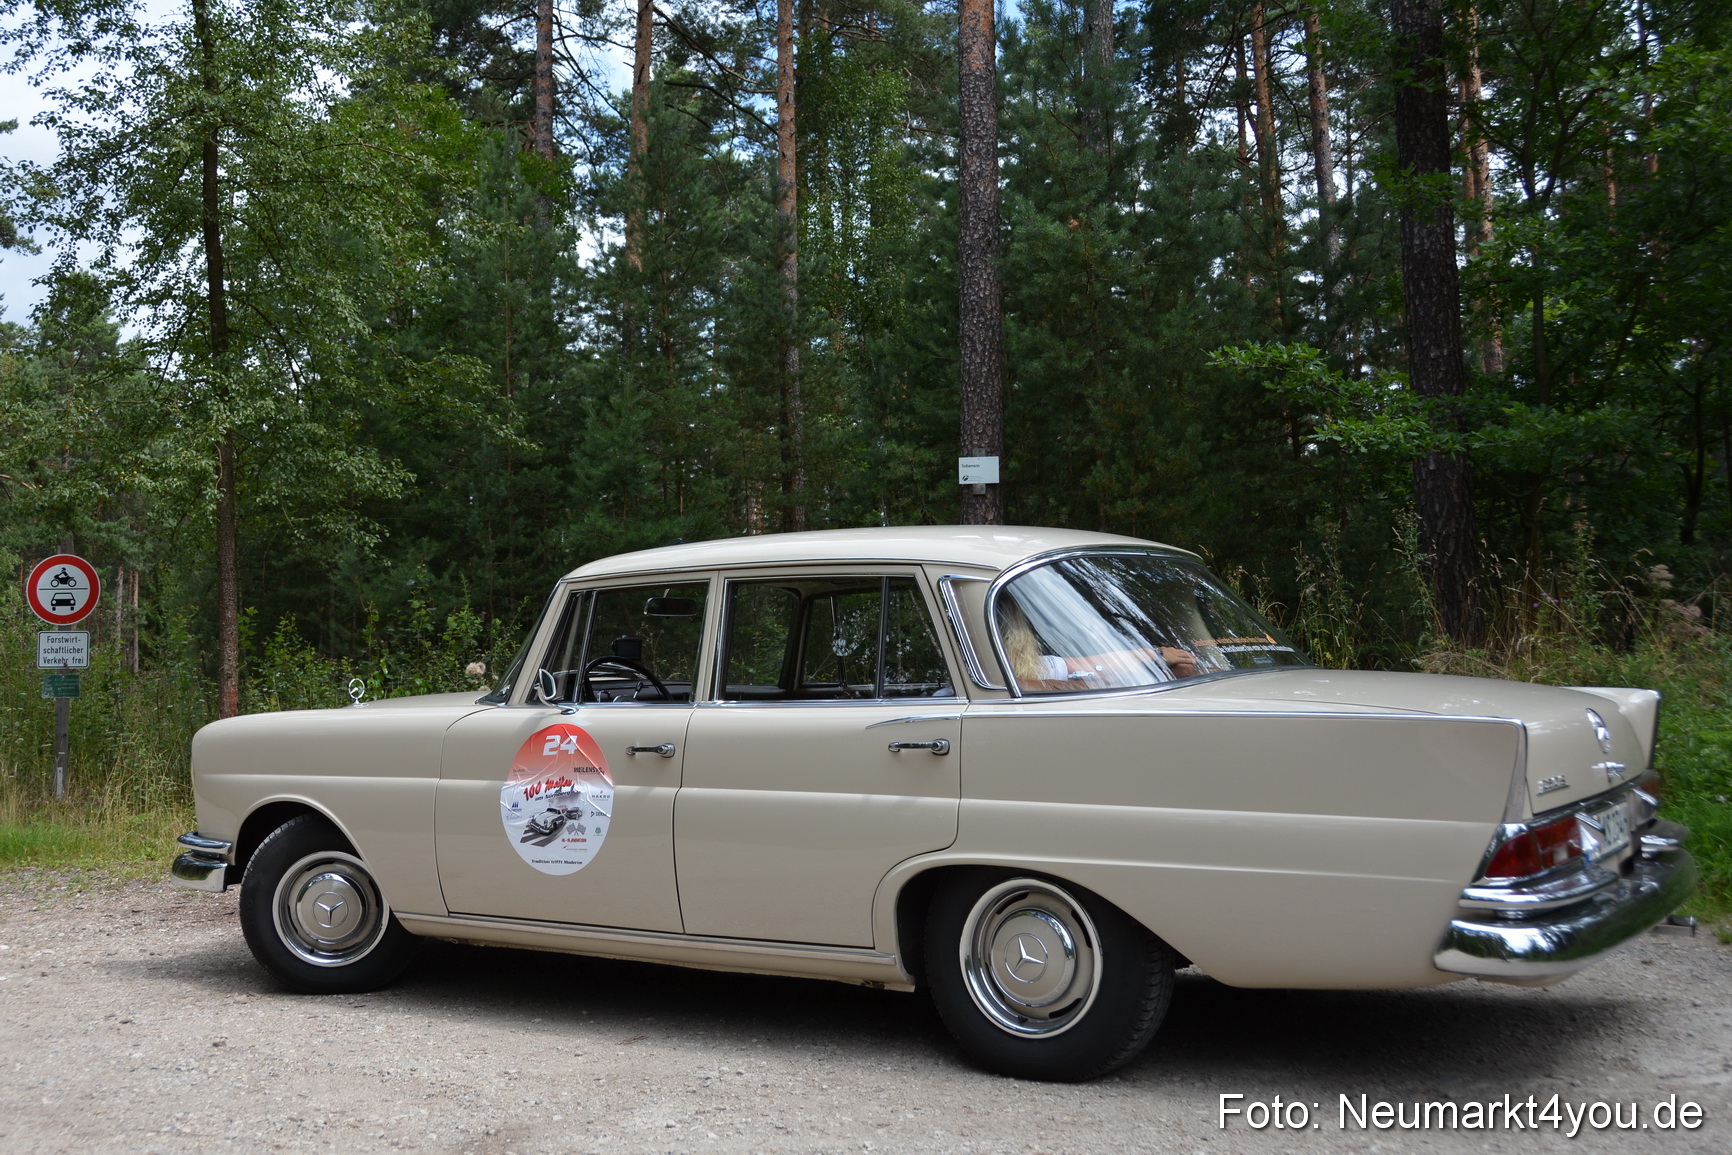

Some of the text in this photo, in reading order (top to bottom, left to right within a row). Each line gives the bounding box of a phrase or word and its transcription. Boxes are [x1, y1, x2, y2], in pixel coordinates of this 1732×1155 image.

[47, 635, 81, 643] Forstwirt-
[43, 646, 84, 654] schaftlicher
[42, 656, 84, 664] Verkehr frei
[542, 734, 578, 756] 24
[523, 780, 542, 801] 100
